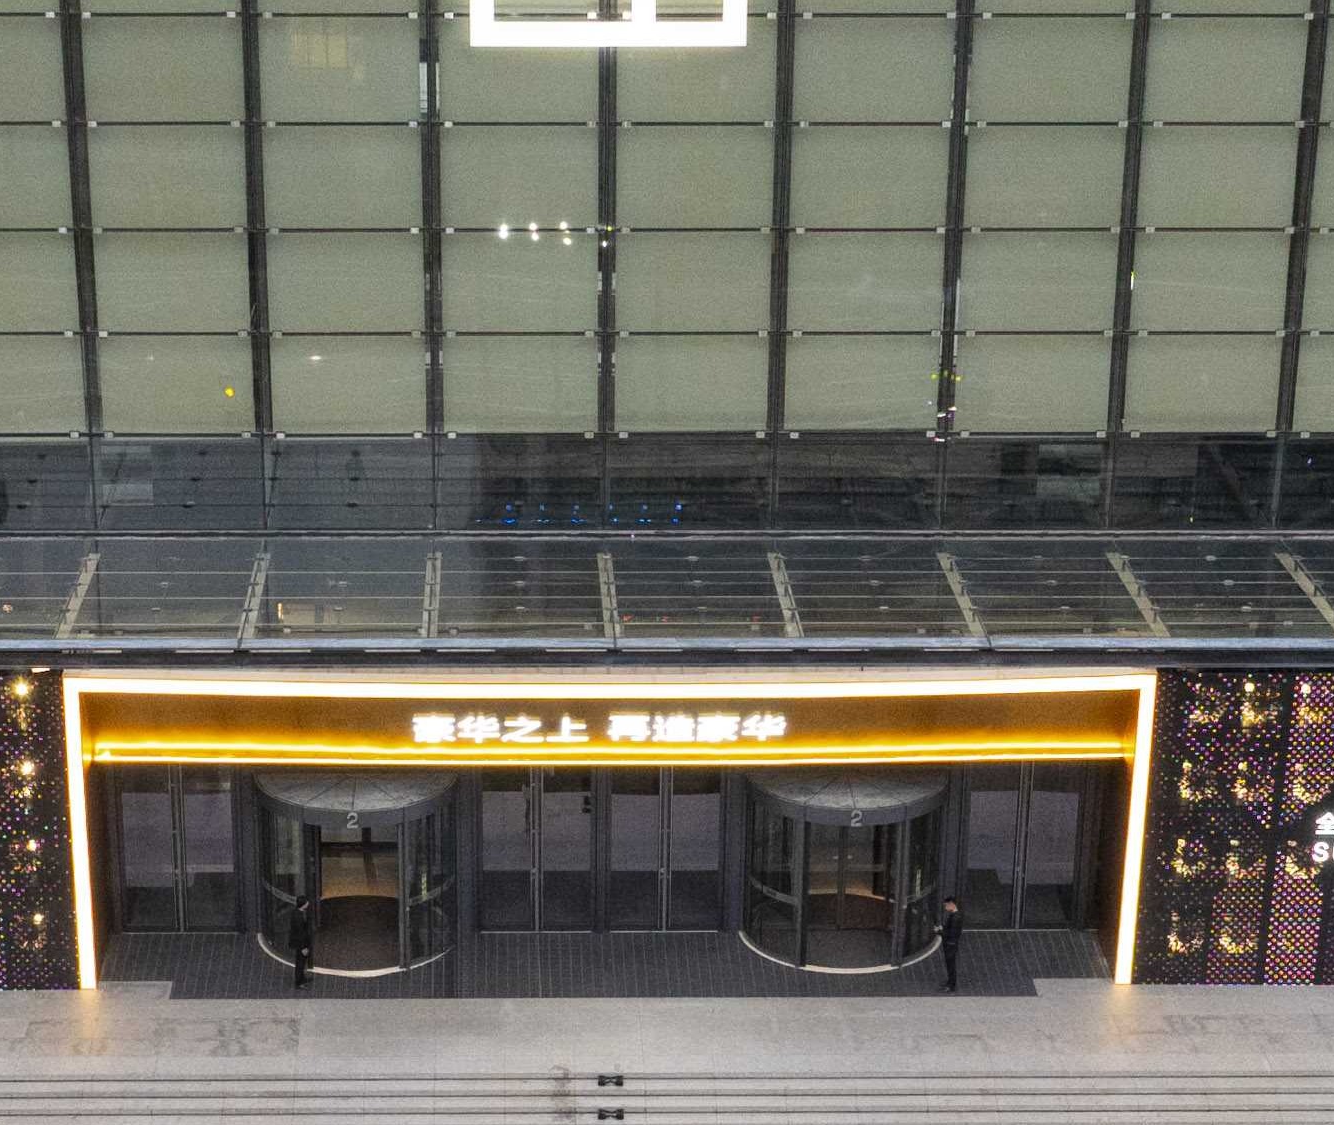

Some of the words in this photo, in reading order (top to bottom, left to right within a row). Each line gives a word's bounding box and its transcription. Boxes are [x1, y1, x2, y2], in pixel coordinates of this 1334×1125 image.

[411, 714, 589, 744] 豪华之上
[346, 812, 360, 829] 2
[850, 809, 863, 827] 2
